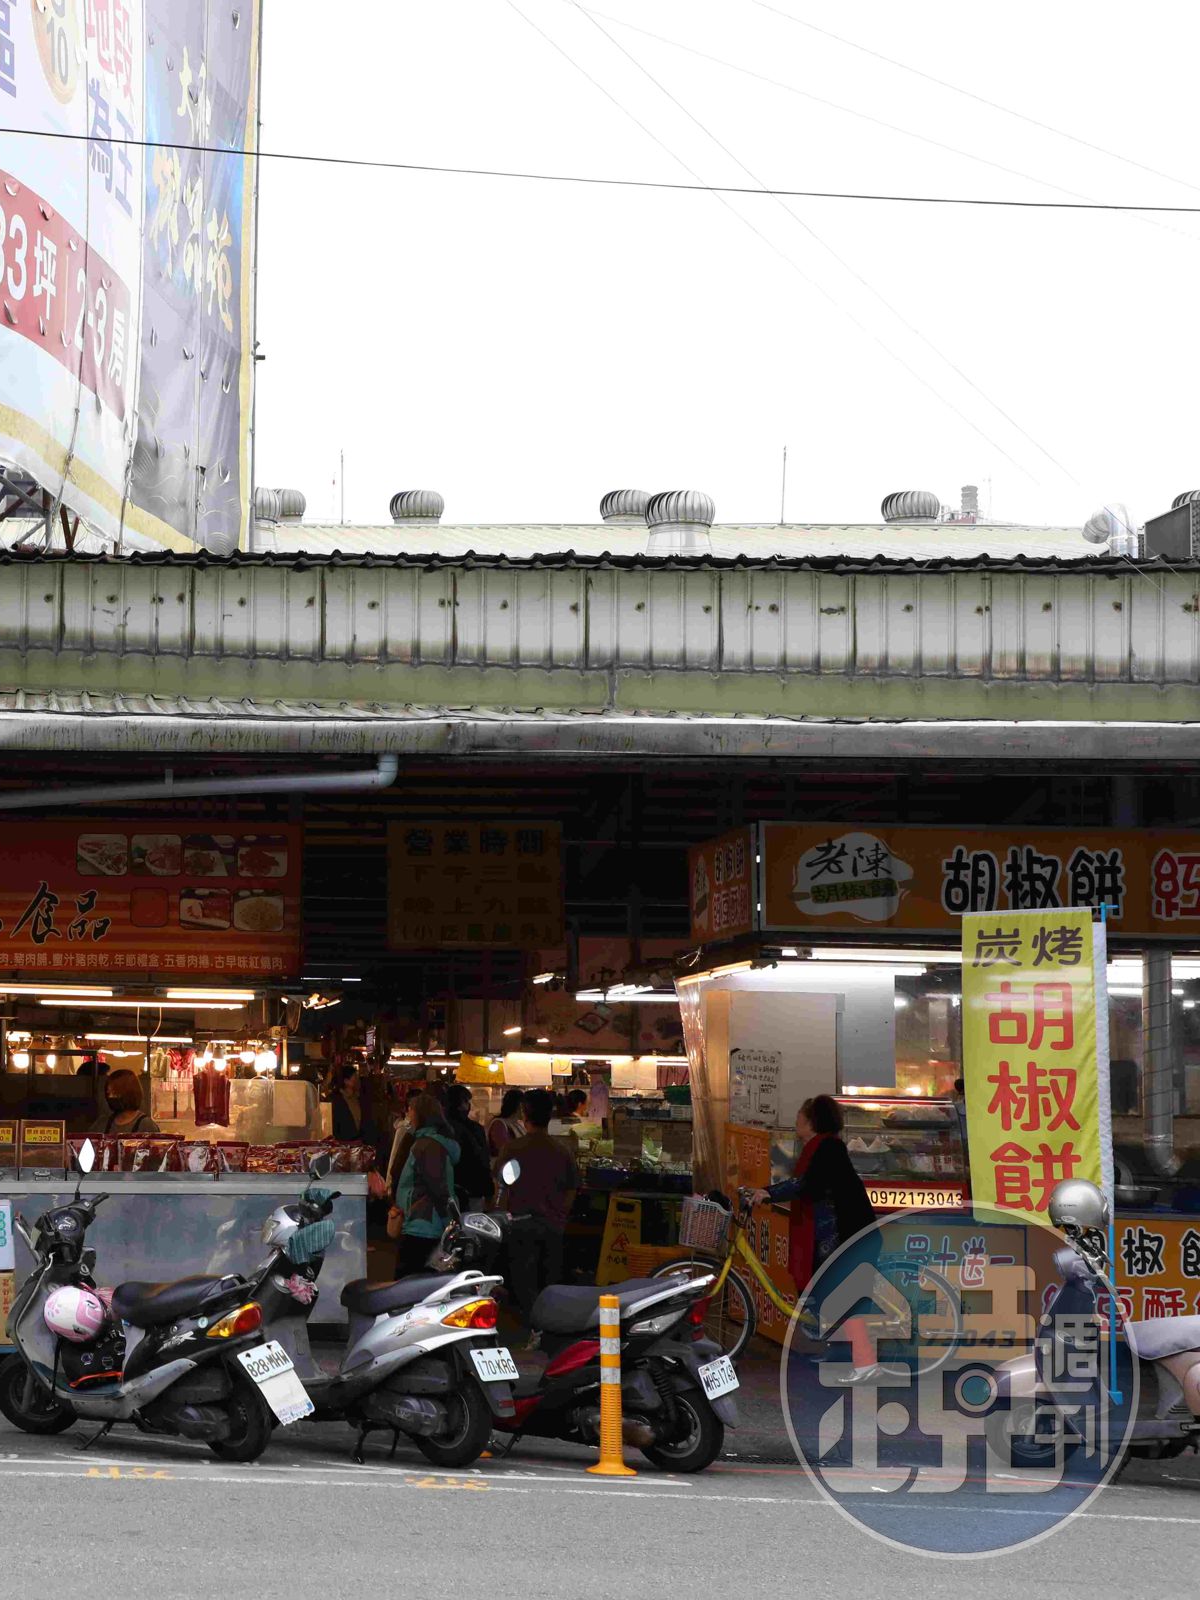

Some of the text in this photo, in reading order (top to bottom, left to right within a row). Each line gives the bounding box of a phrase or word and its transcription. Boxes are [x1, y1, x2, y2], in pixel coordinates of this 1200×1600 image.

[76, 267, 126, 386] 2-3房
[945, 847, 1124, 917] 胡椒餅
[973, 925, 1084, 968] 炭烤
[987, 982, 1081, 1212] 胡椒餅
[870, 1190, 963, 1207] 0972173043
[246, 1350, 290, 1377] 828-MHW
